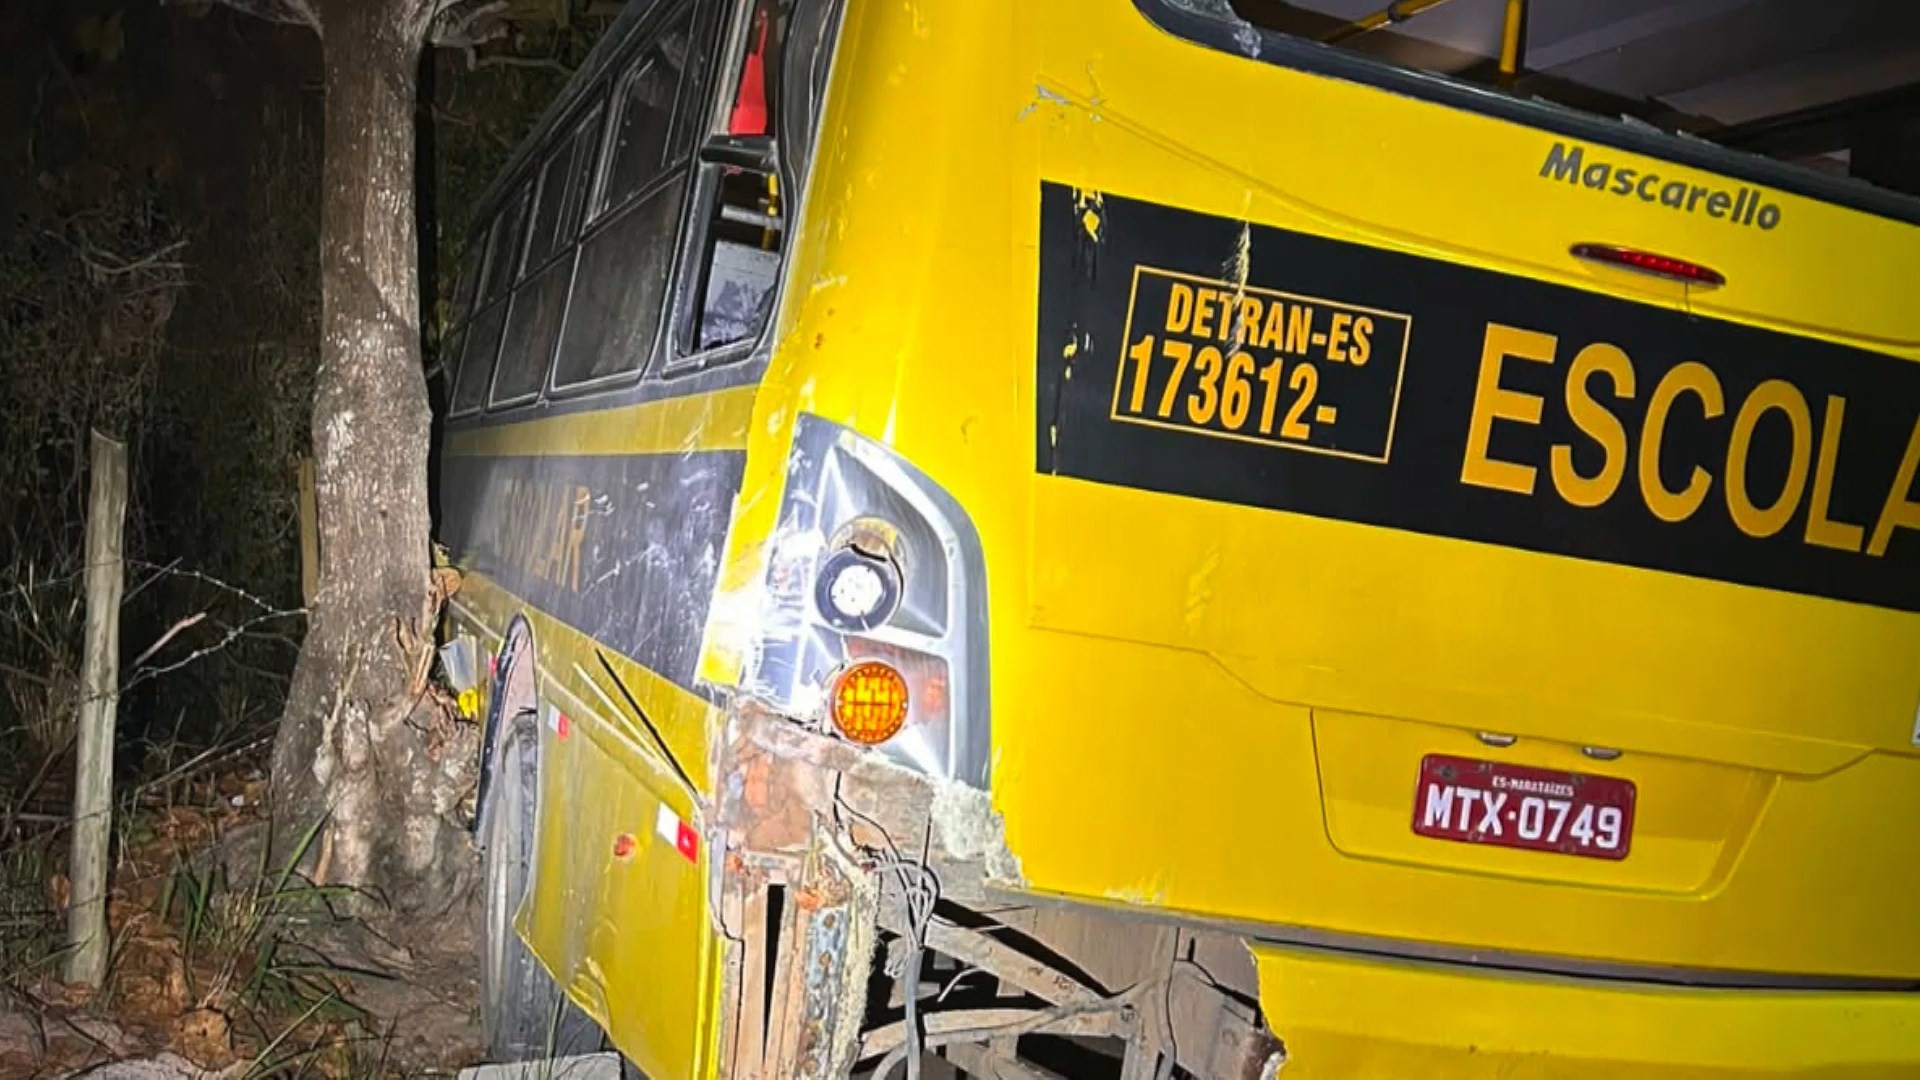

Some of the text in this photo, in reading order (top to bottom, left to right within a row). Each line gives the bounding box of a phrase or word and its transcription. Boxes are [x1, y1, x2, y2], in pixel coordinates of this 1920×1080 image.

[1539, 142, 1781, 230] Mascarello
[1165, 282, 1374, 366] DETRAN-ES
[1129, 334, 1337, 440] 173612-
